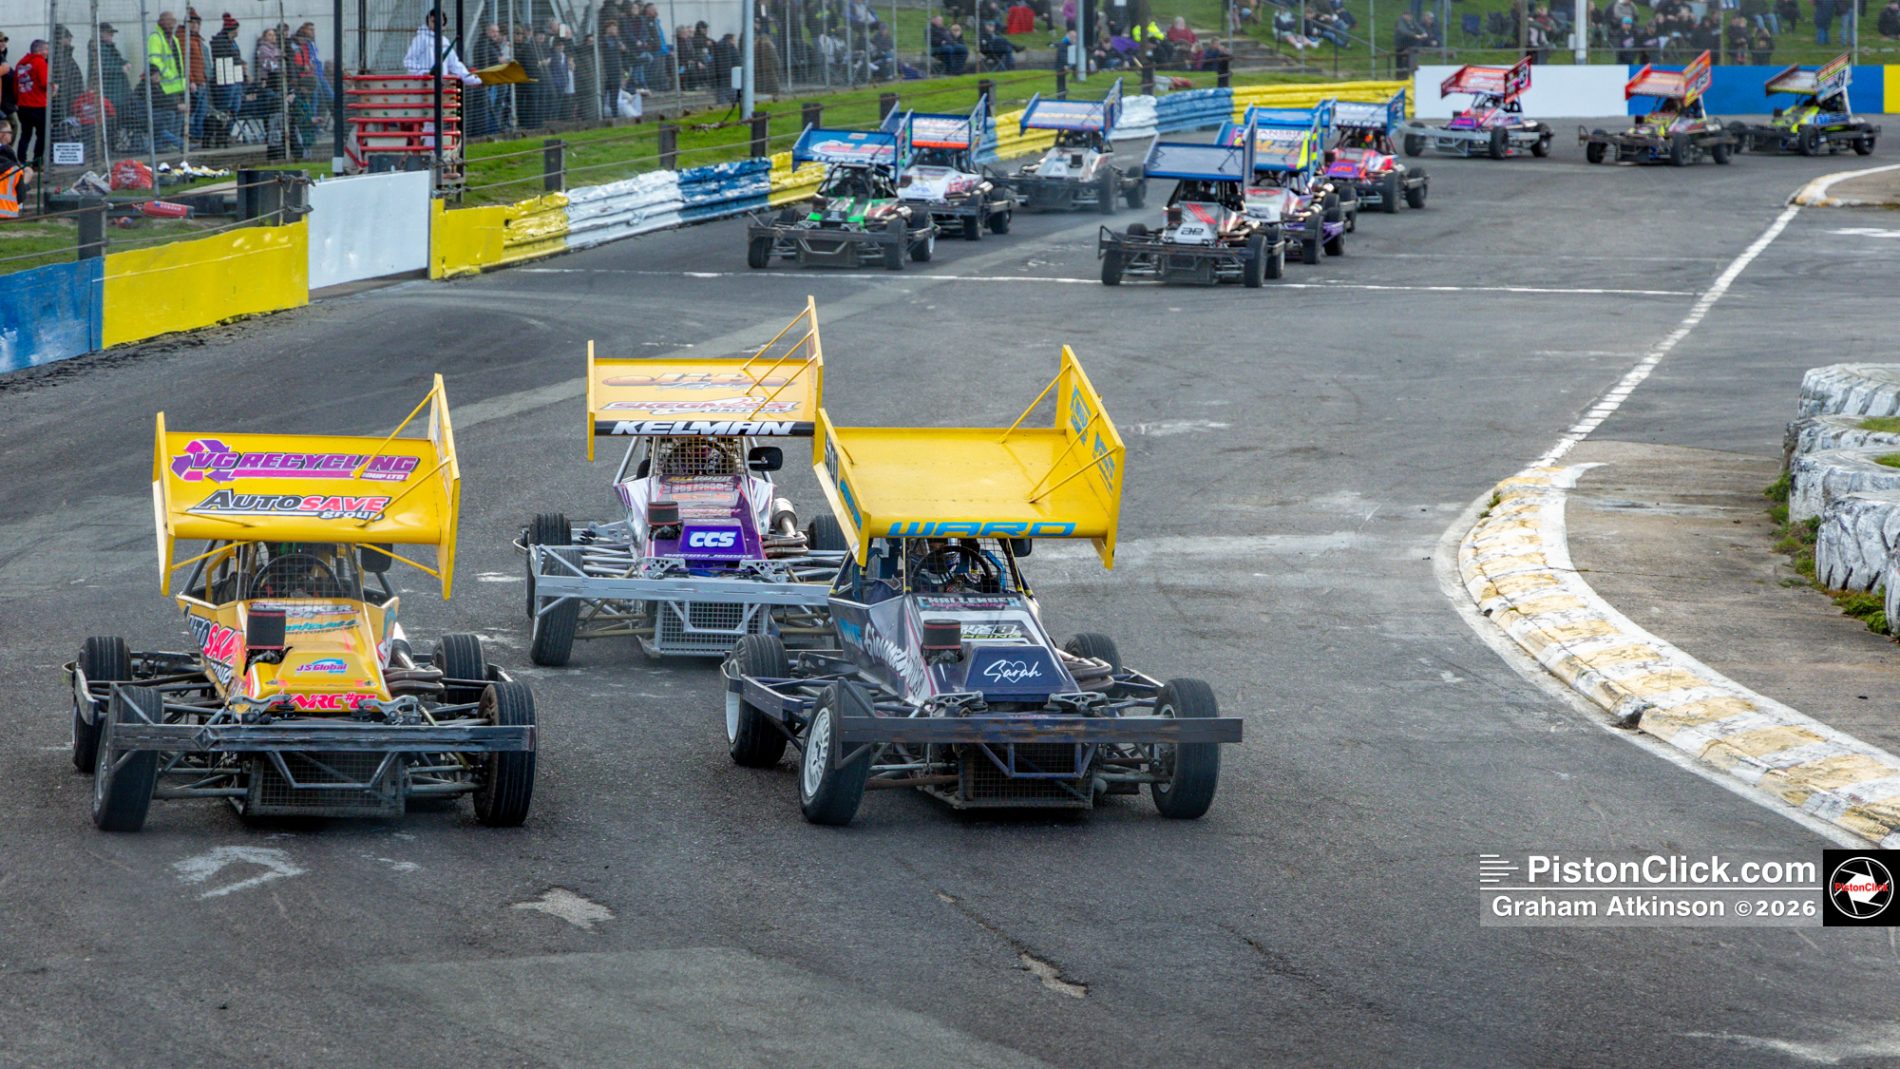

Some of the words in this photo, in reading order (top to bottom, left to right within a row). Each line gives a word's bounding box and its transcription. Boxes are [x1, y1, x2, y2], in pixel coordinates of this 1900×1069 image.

[611, 420, 796, 436] KELMAN
[192, 452, 239, 469] VG
[238, 453, 420, 473] RECYCLING
[887, 521, 1076, 537] WARD
[689, 531, 737, 548] CCS
[312, 663, 348, 673] Global
[983, 659, 1043, 684] Sarah
